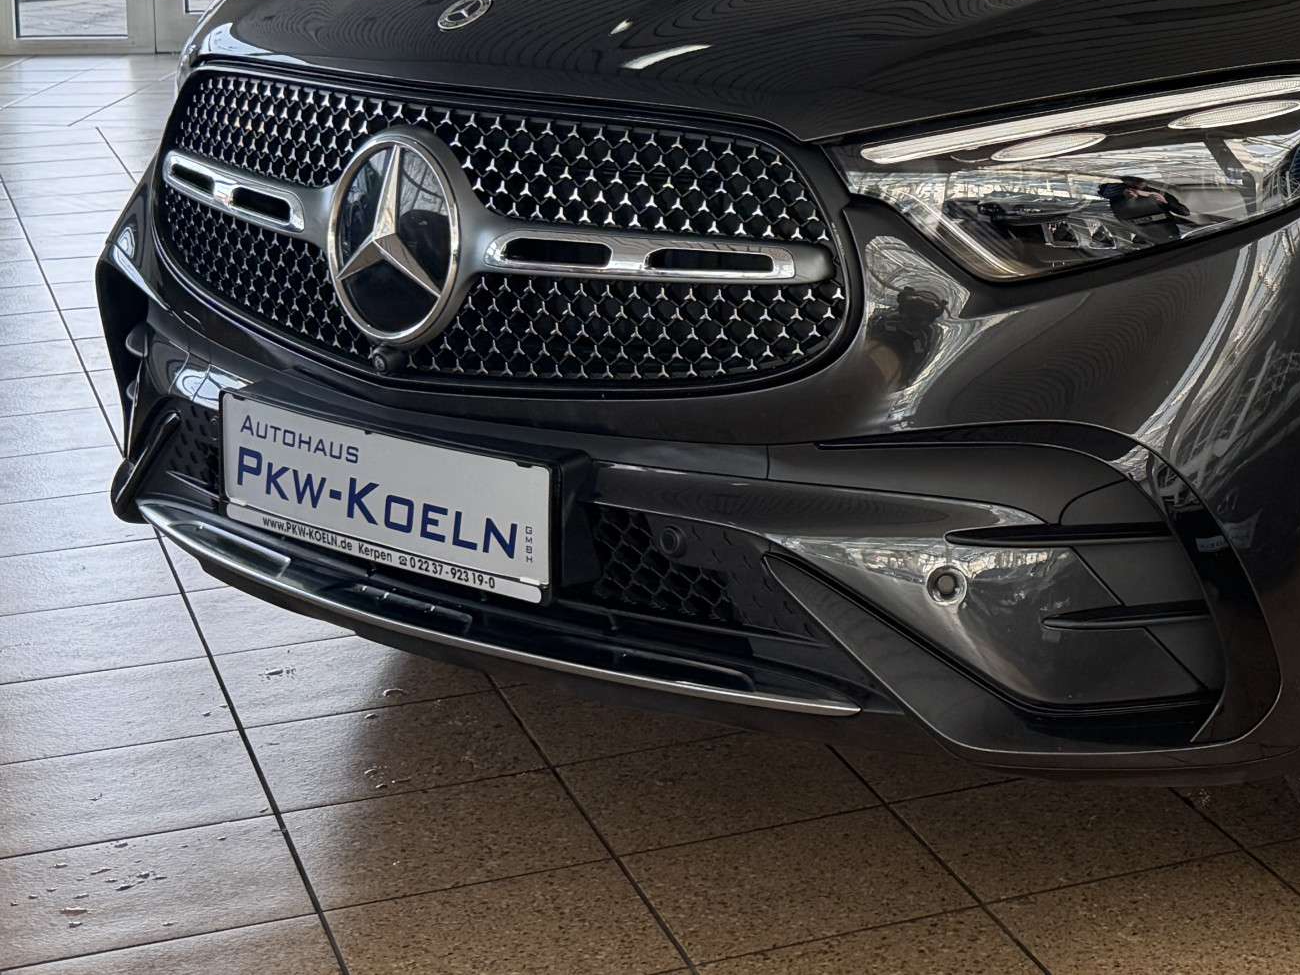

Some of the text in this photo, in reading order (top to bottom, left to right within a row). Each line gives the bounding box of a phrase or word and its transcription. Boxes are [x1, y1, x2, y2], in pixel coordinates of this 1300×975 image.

[240, 414, 360, 464] AUTOHAUS
[237, 446, 518, 560] PKW-KOELN
[262, 516, 353, 551] www.PKW-KOELN.de
[358, 542, 393, 563] Kerpen
